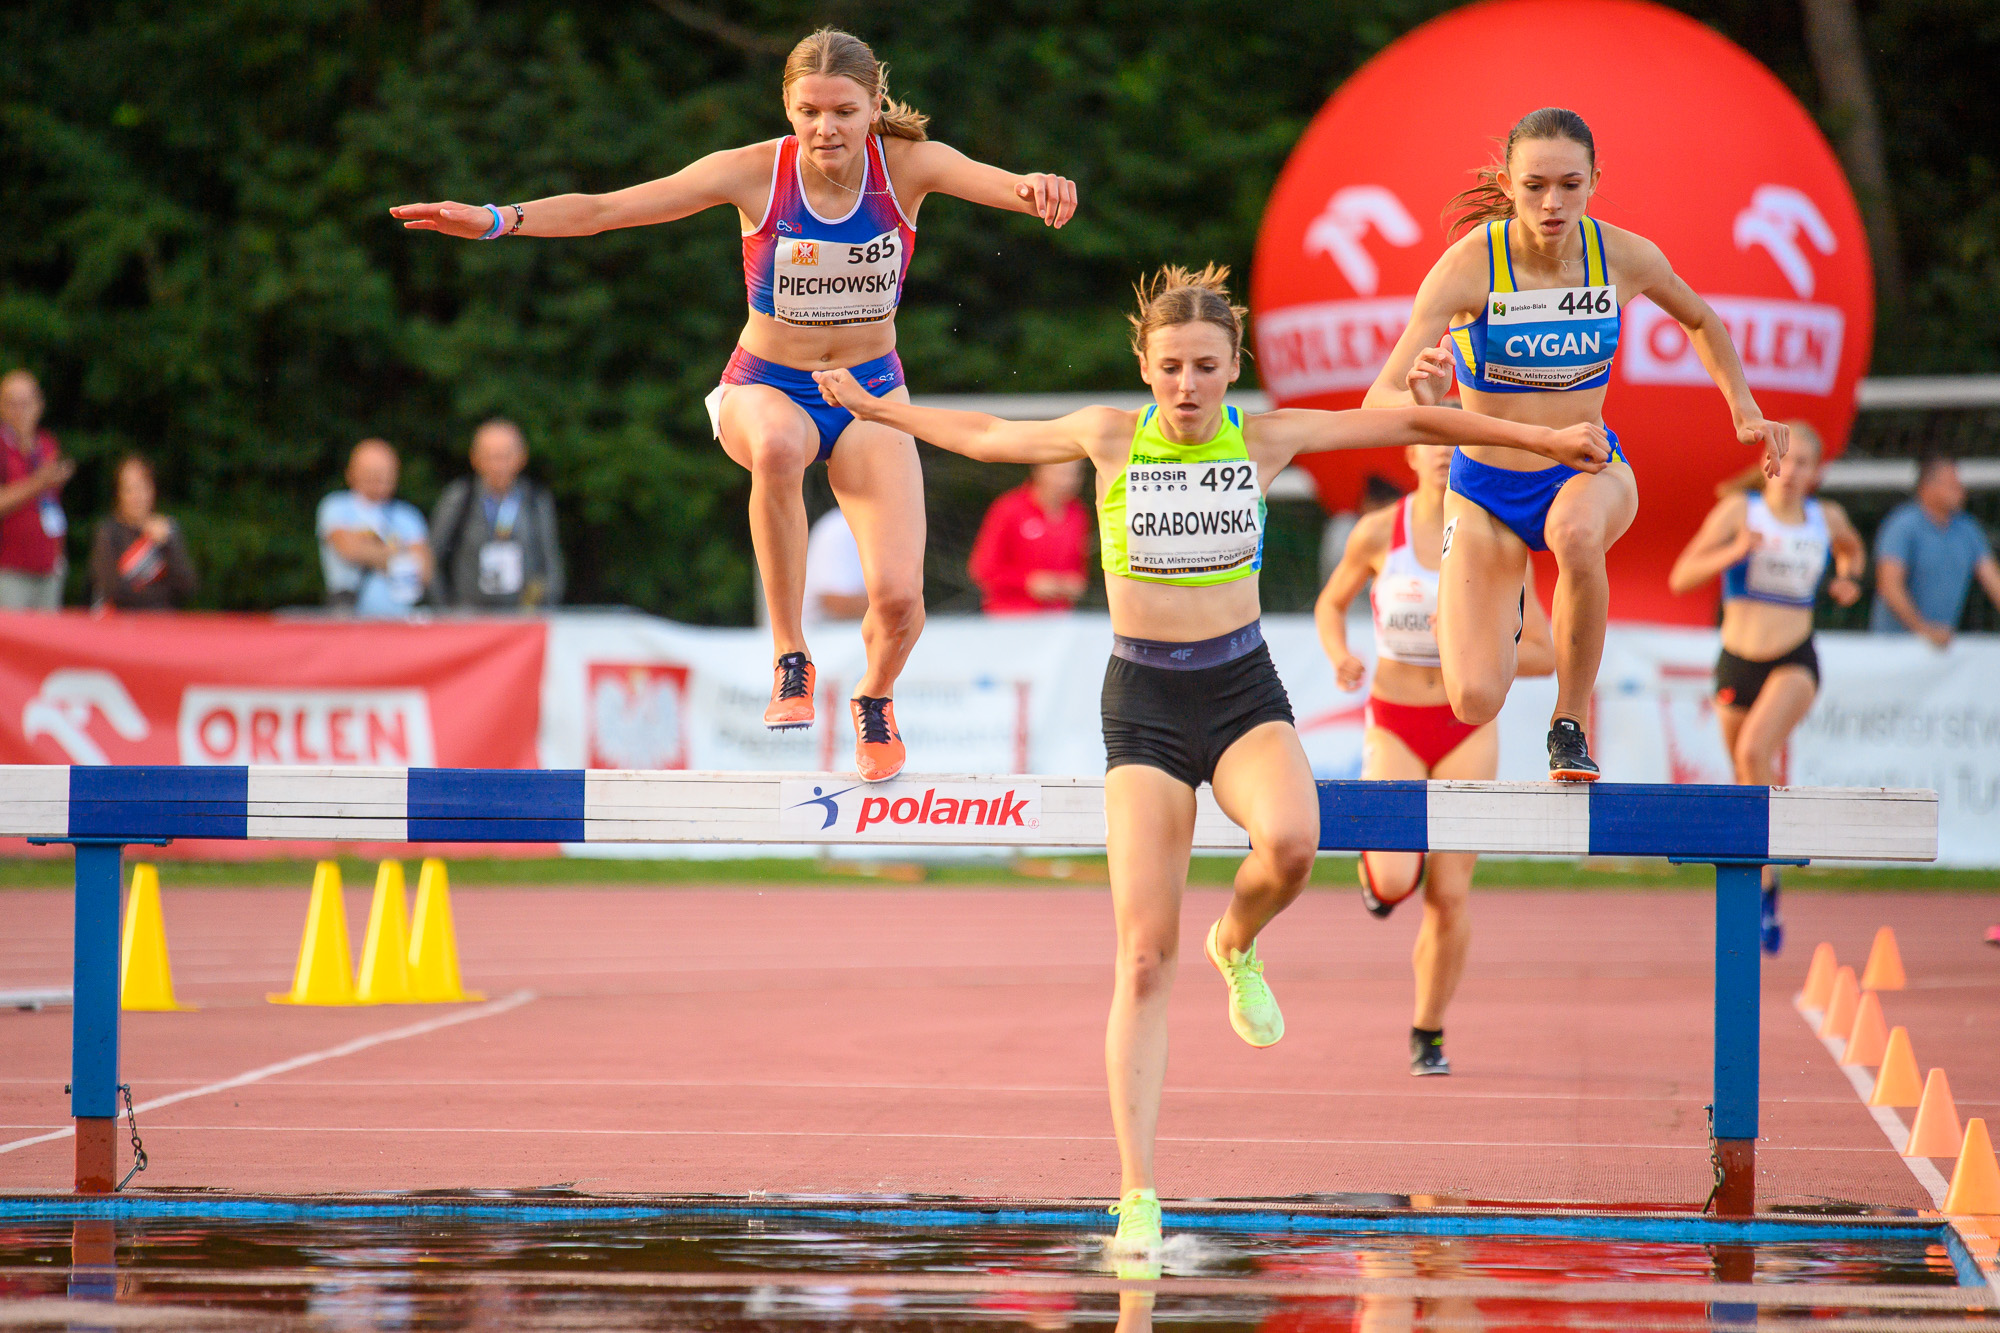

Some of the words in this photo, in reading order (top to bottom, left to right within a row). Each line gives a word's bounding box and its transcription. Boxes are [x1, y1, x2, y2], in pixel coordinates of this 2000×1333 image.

[847, 235, 895, 265] 585
[778, 269, 897, 296] PIECHOWSKA
[811, 309, 860, 318] Mistrzostwa
[861, 306, 885, 315] Polski
[1558, 290, 1611, 315] 446
[1504, 331, 1600, 358] CYGAN
[1648, 316, 1831, 371] OLEN
[1503, 370, 1522, 378] PZLA
[1524, 372, 1572, 380] Mistrzostwa
[1130, 471, 1187, 481] BBOSiR
[1199, 465, 1254, 492] 492
[1131, 508, 1257, 537] GRABOWSKA
[1144, 556, 1164, 565] PZLA
[1166, 556, 1217, 565] Mistrzostwa
[1386, 613, 1431, 632] AUGUS
[1169, 648, 1194, 661] 4F
[198, 707, 409, 763] ORLEN
[855, 788, 1031, 834] polanik
